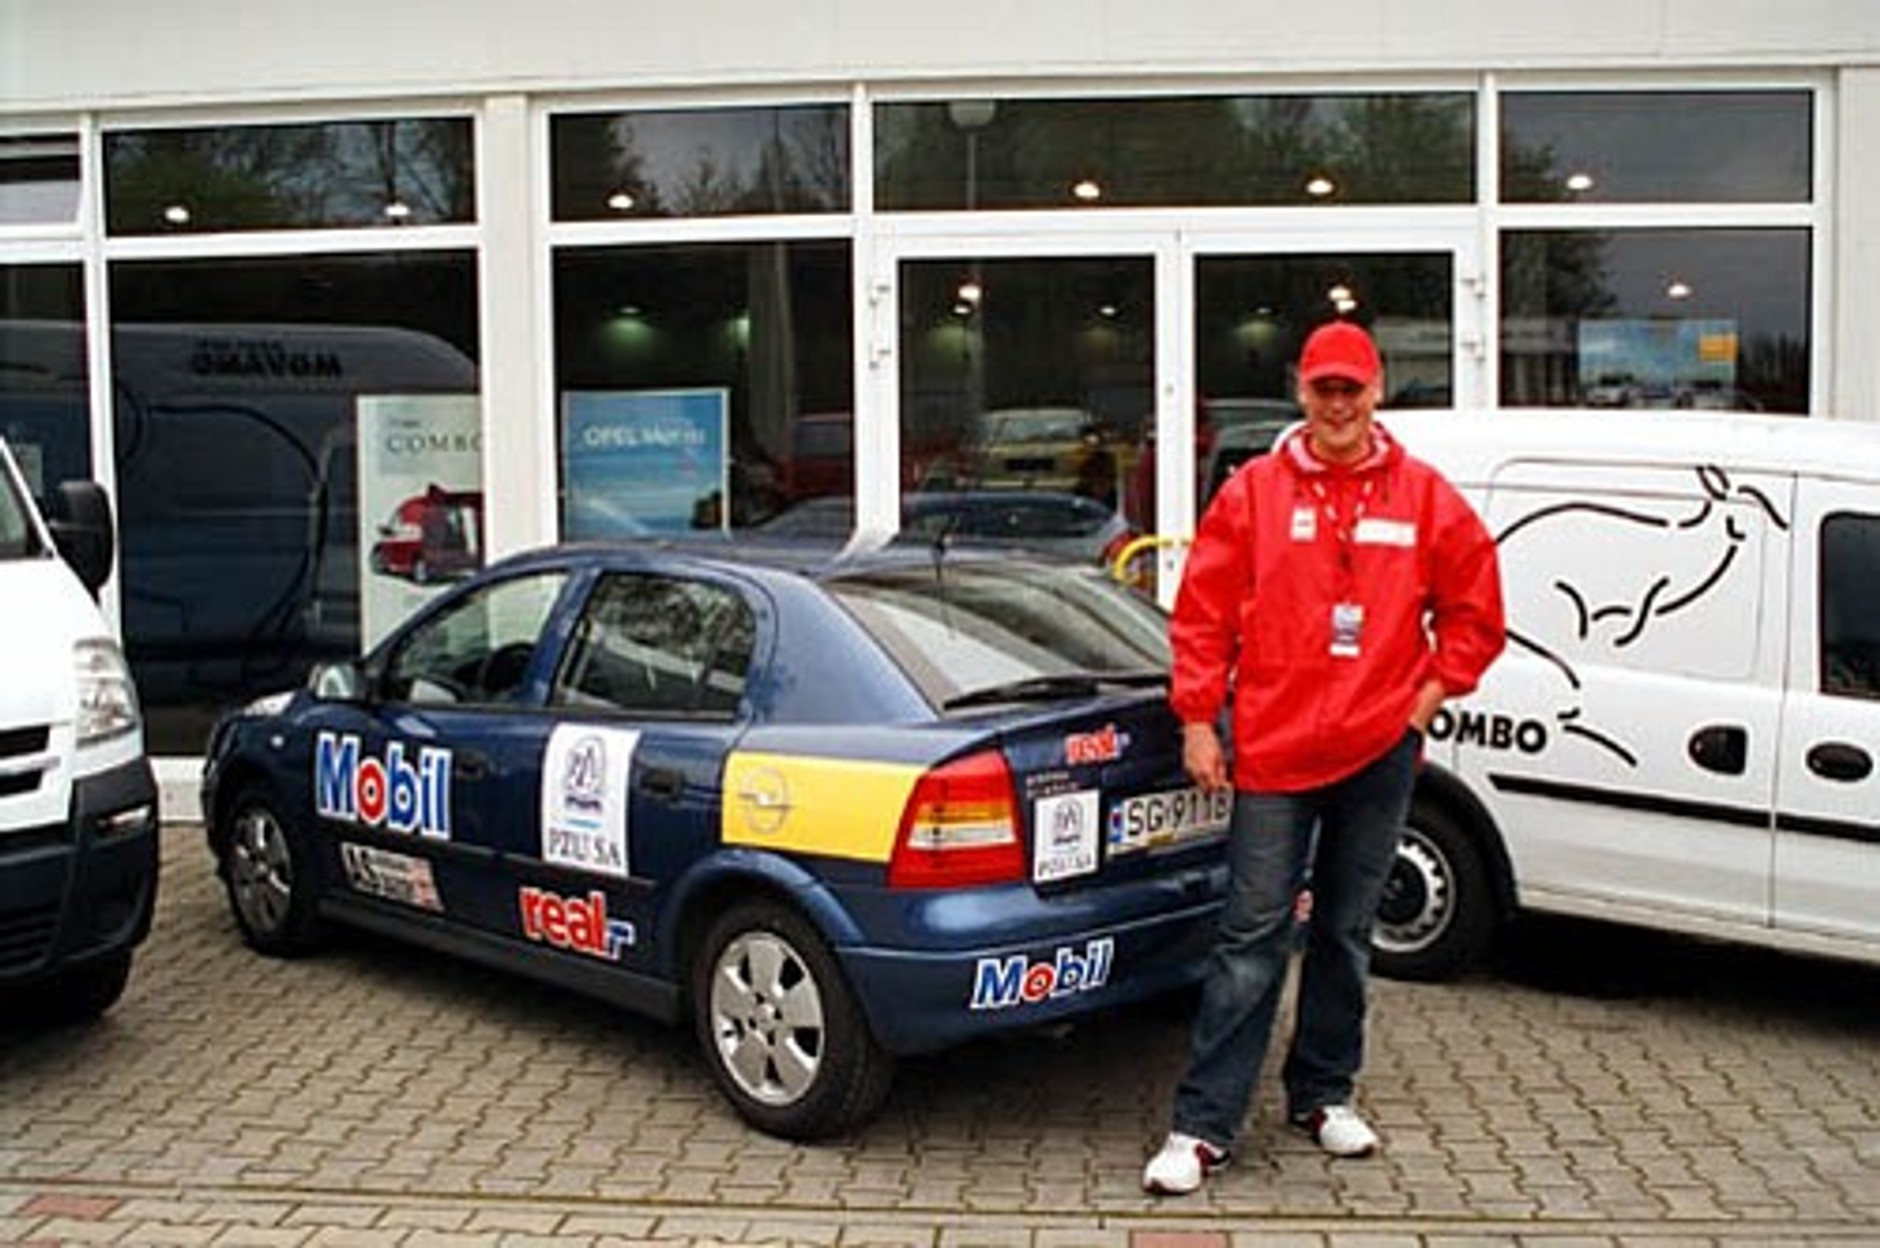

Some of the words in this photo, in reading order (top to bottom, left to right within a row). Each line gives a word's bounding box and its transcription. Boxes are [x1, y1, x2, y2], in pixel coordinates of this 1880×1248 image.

[1426, 707, 1547, 752] OMBO
[316, 731, 451, 840] Mobil
[970, 937, 1114, 1009] Mobil
